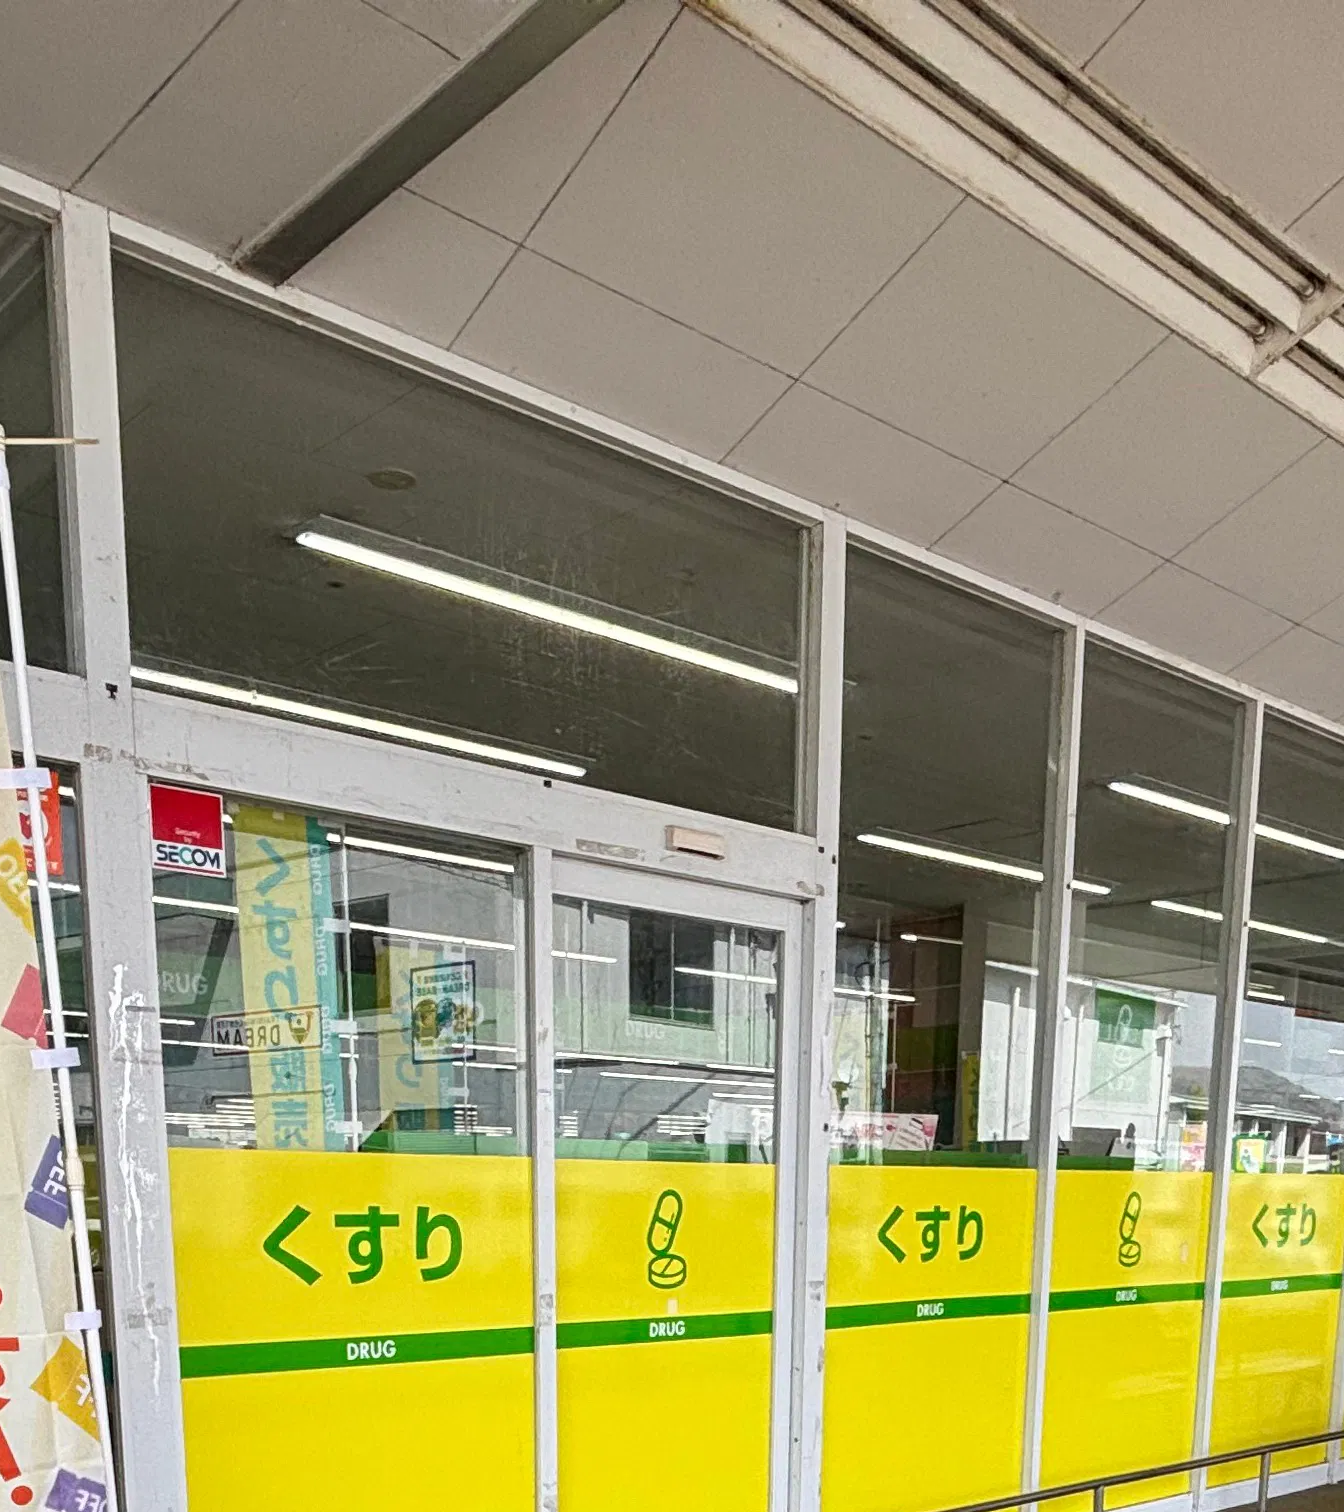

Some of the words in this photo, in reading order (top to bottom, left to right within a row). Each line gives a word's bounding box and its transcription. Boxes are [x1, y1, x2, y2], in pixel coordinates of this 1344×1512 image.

[156, 843, 221, 870] SECOM
[876, 1204, 985, 1264] くすり
[1251, 1202, 1317, 1248] くすり
[261, 1204, 464, 1287] くすり
[1114, 1288, 1138, 1303] DRUG
[916, 1302, 945, 1318] DRUG
[648, 1320, 686, 1339] DRUG
[346, 1340, 397, 1362] DRUG
